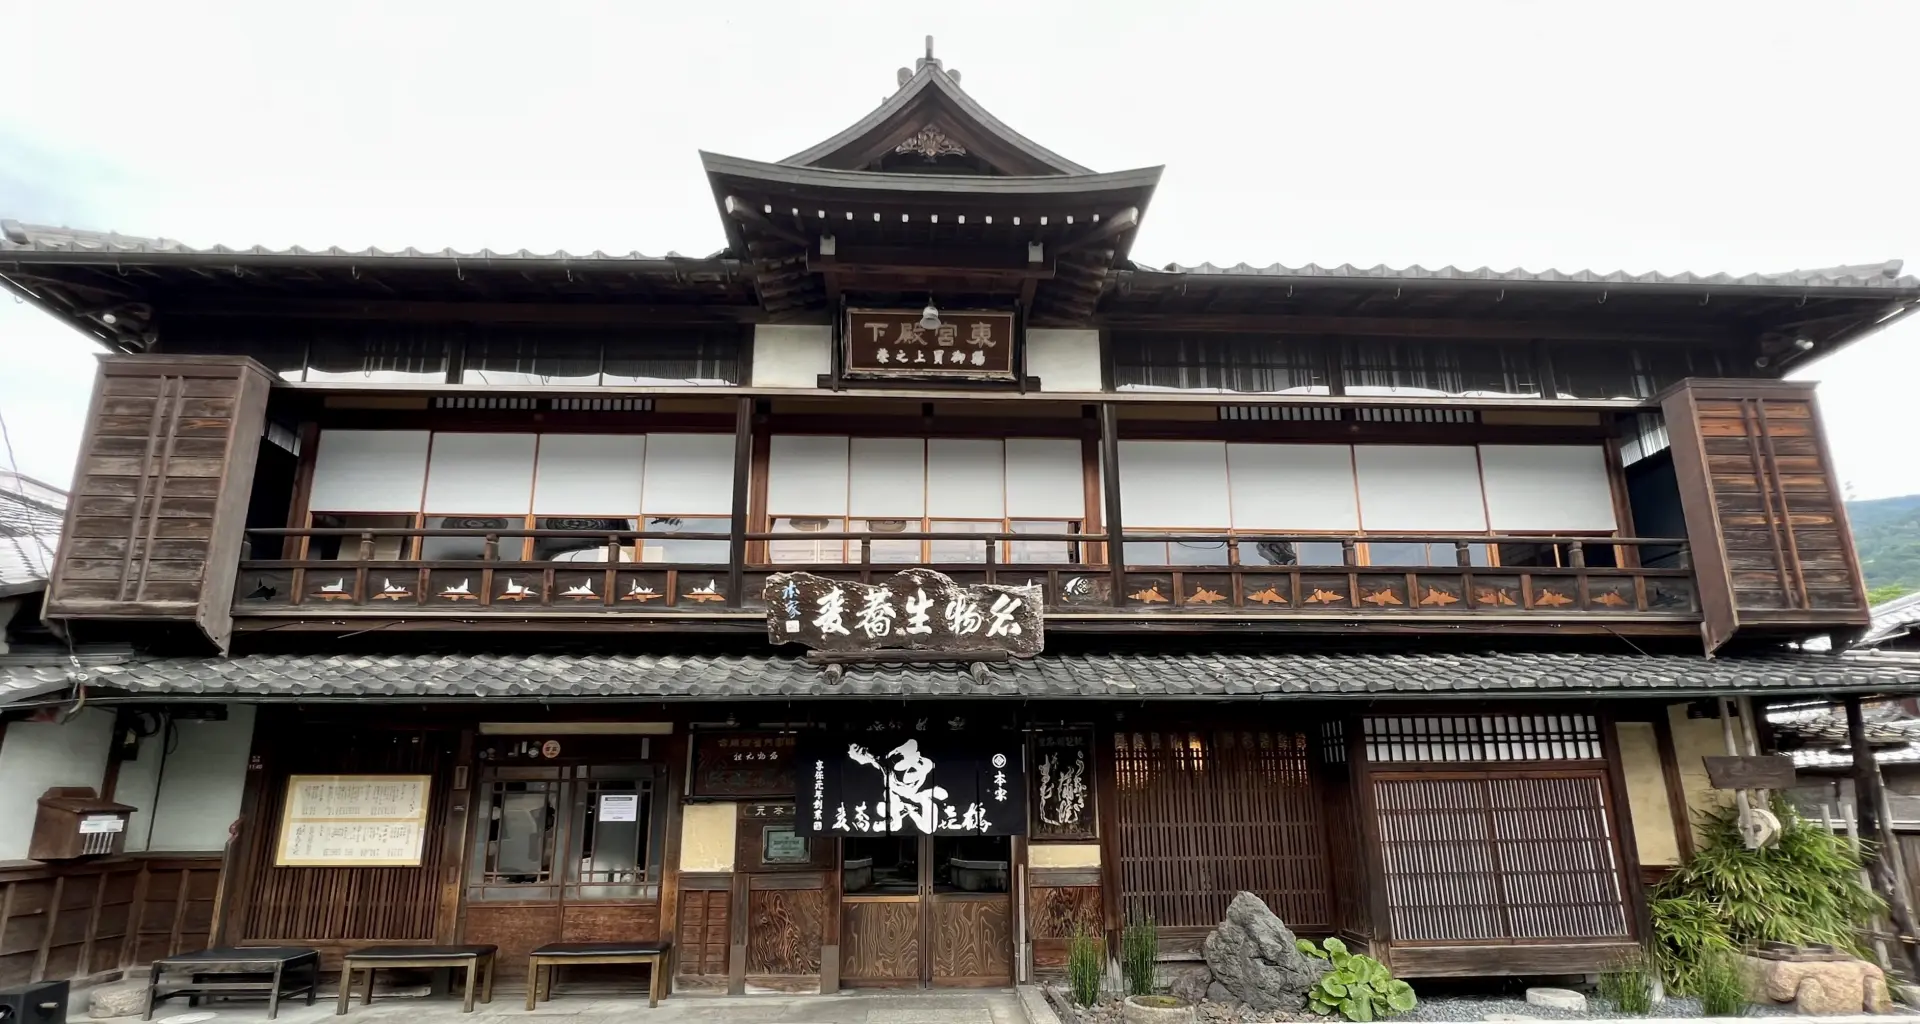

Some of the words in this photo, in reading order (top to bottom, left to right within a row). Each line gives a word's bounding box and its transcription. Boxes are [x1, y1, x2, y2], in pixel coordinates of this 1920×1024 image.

[864, 321, 997, 349] 東宮殿下
[812, 759, 825, 821] 享保元年創業
[993, 770, 1008, 802] 本家
